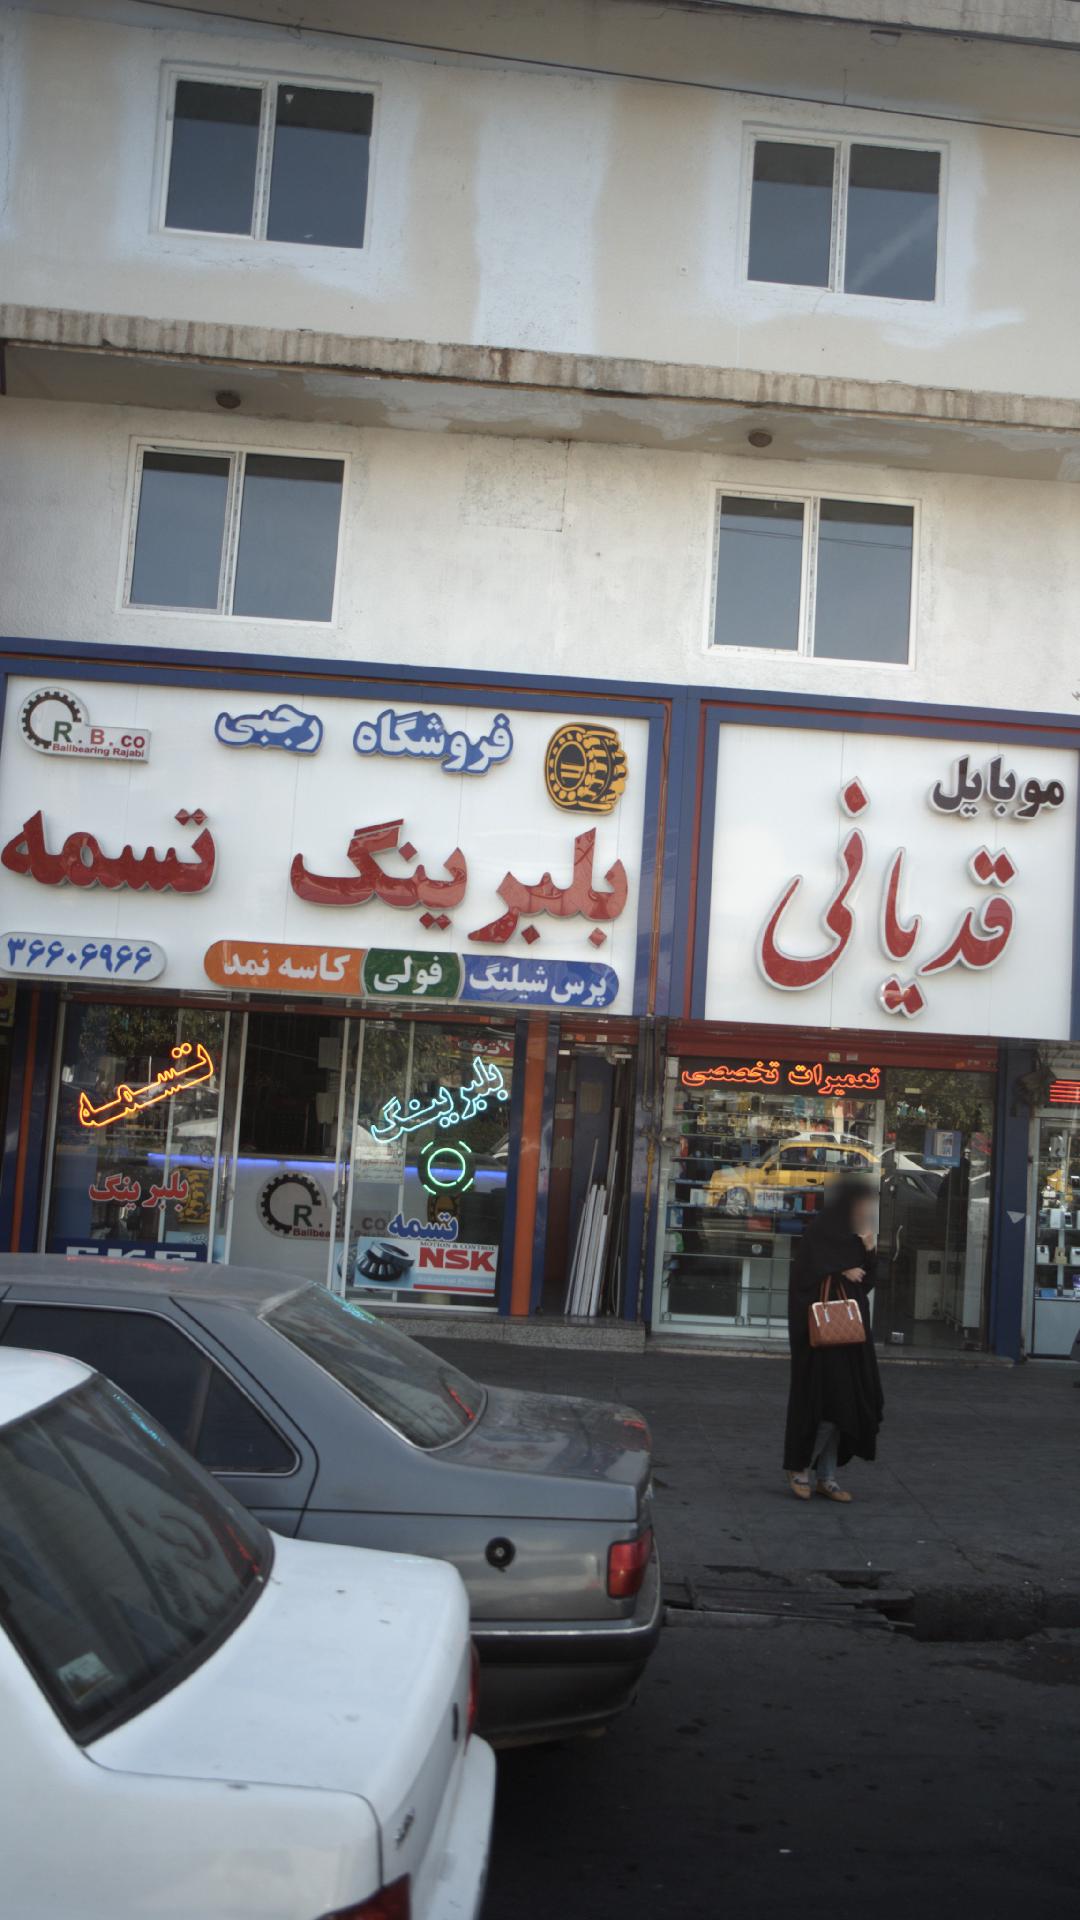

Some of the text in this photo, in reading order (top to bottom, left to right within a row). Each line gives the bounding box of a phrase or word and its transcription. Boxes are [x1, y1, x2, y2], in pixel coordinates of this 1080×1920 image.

[52, 743, 145, 758] Ballbearing Rajabi
[216, 706, 512, 772] فروشگاه رجبی
[932, 755, 1065, 819] موبایل
[1, 808, 629, 949] بلبرینگ تسمه
[7, 937, 153, 974] ۳۶۶۰۶۹۶۶
[223, 949, 351, 982] کاسه نمد
[373, 955, 443, 994] فولی
[469, 963, 607, 1006] پرس شیلنگ
[79, 1042, 214, 1127] تسمه
[681, 1061, 882, 1096] تعمیرات تخصصی
[370, 1056, 509, 1144] بلبرینگ
[89, 1170, 189, 1212] بلبرینگ
[387, 1211, 459, 1242] تسمه
[419, 1247, 496, 1272] NSK
